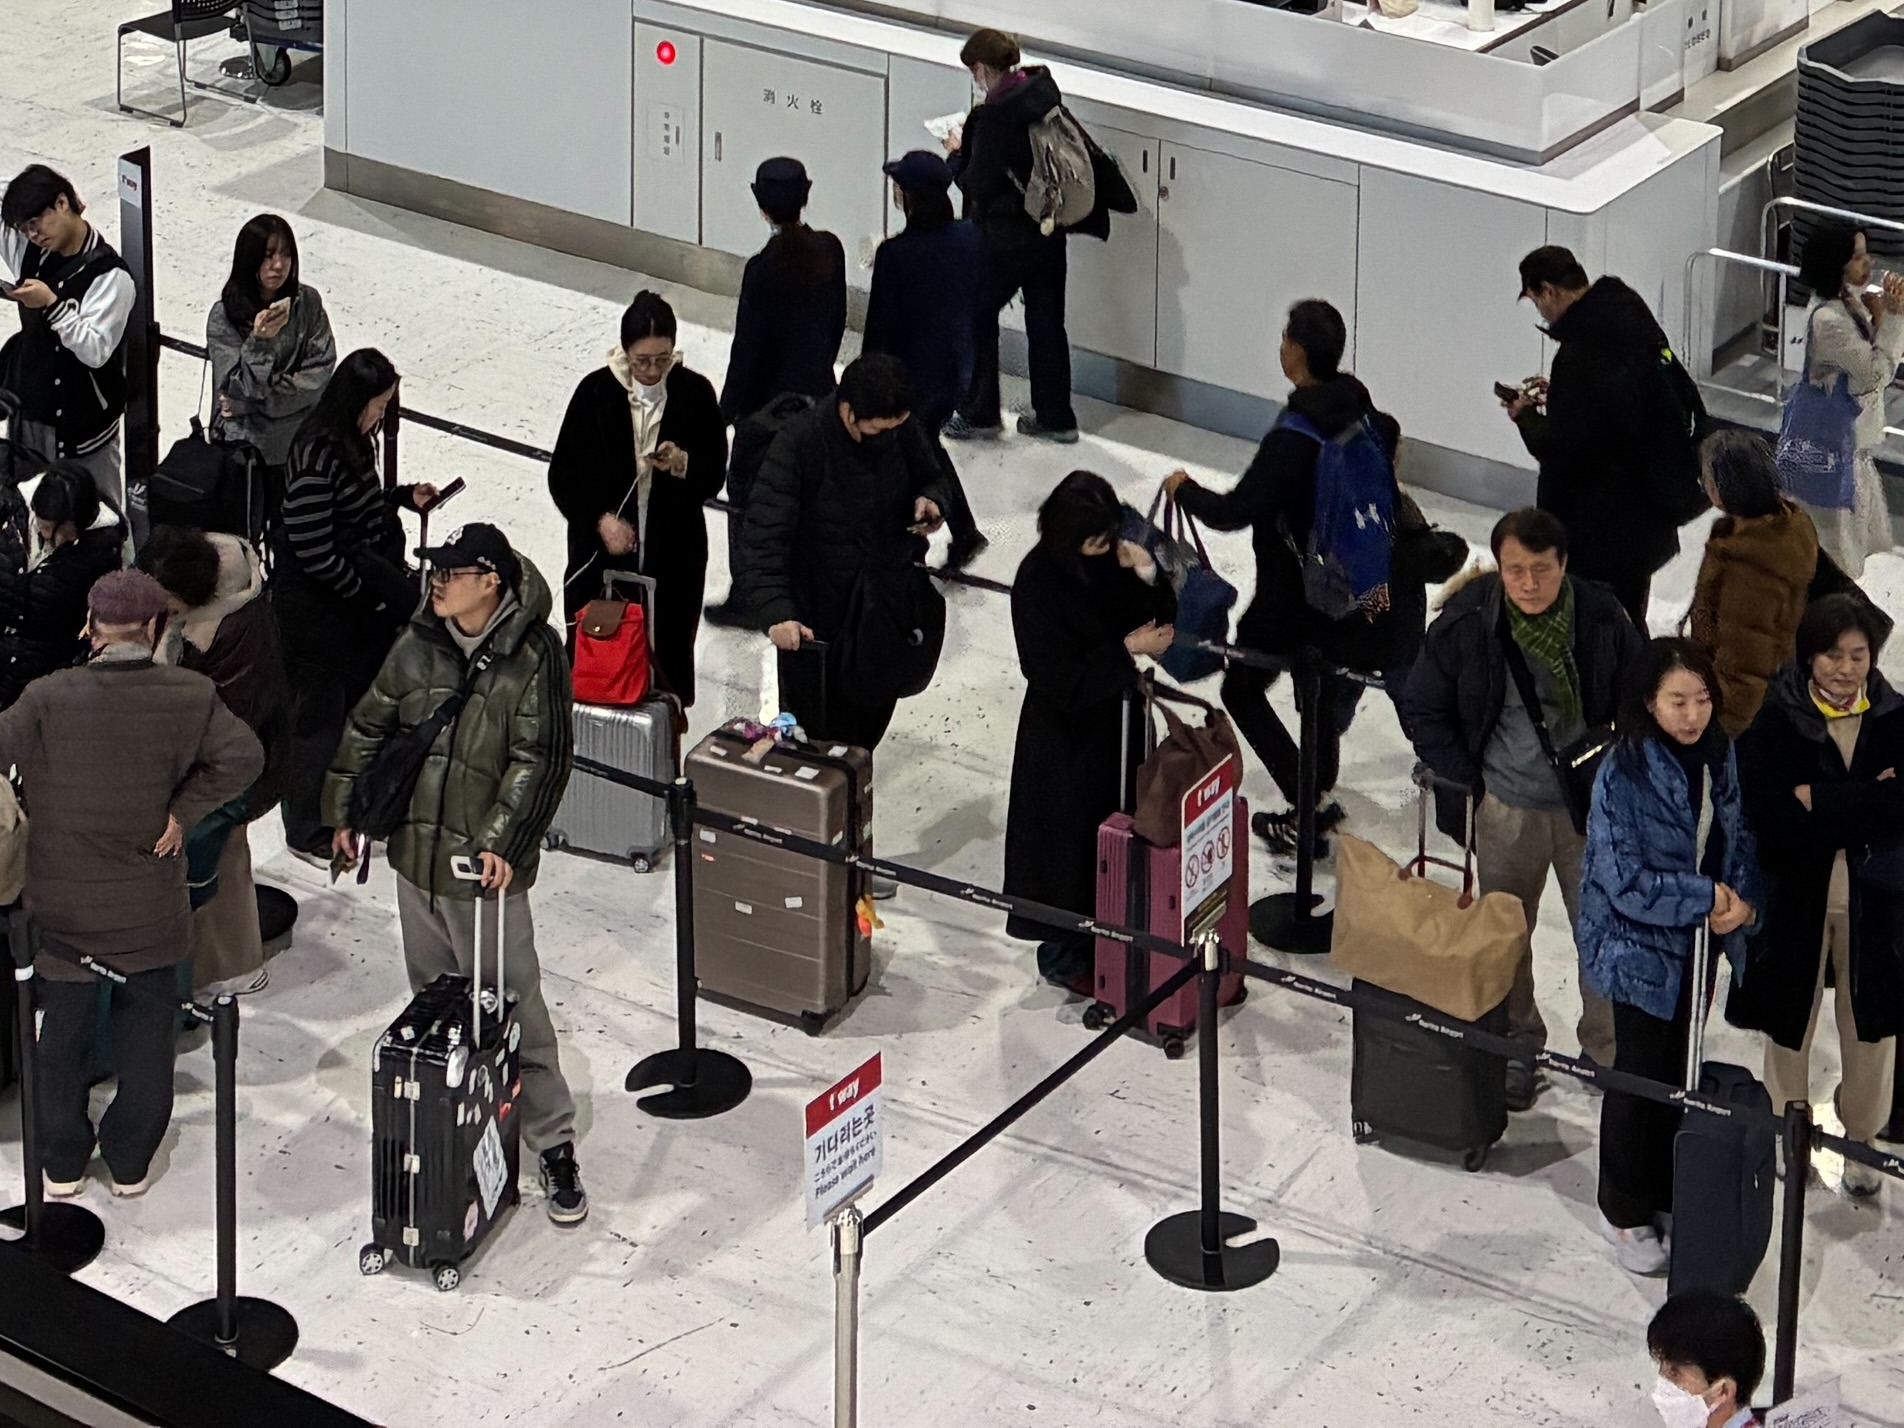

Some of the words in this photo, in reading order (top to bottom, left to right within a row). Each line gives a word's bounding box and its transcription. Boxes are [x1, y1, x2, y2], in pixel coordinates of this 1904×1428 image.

[816, 1175, 839, 1200] Please
[841, 1158, 858, 1180] wait
[859, 1146, 876, 1166] here
